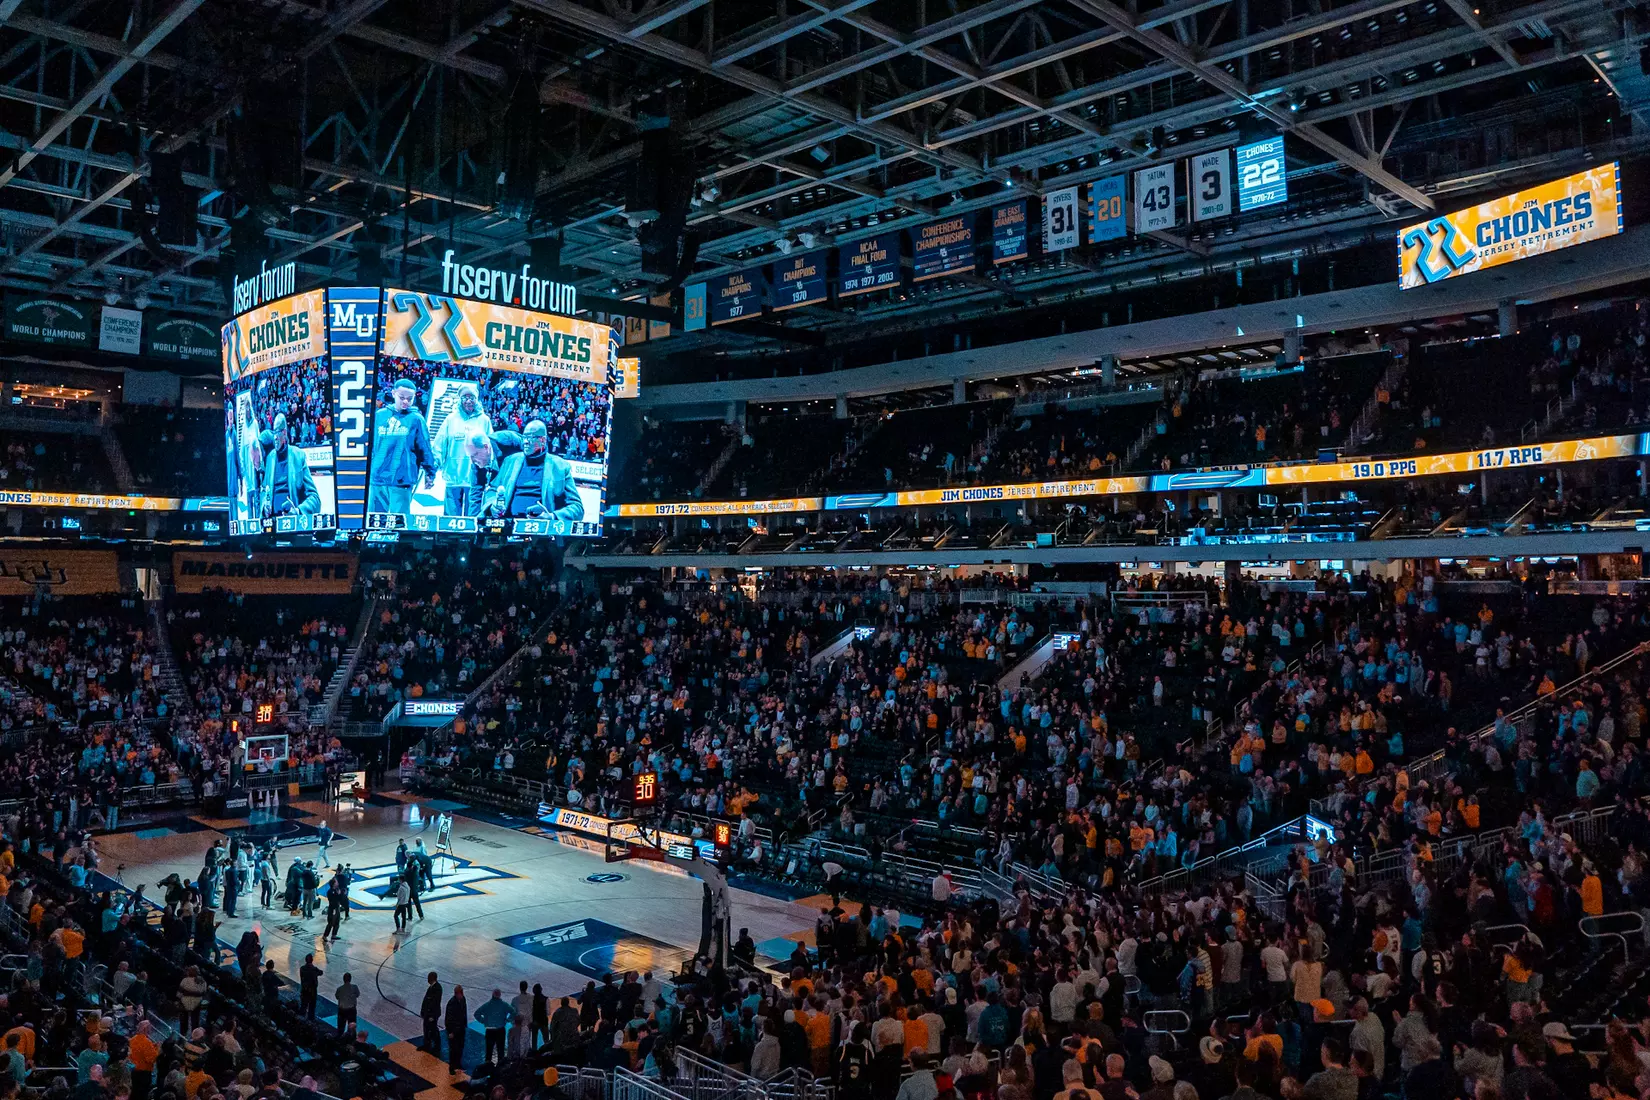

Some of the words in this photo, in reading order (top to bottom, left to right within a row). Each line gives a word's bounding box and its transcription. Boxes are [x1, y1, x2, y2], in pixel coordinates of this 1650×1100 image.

[1245, 144, 1273, 158] CHONES
[1202, 156, 1219, 168] WADE
[1148, 171, 1166, 181] TATUM
[1243, 158, 1280, 188] 22
[1202, 170, 1221, 200] 3
[1053, 193, 1072, 204] RIVERS
[1143, 185, 1170, 212] 43
[1523, 199, 1538, 209] JIM
[1098, 196, 1120, 221] 20
[1052, 204, 1074, 234] 31
[1476, 192, 1592, 248] CHONES
[922, 218, 964, 238] CONFERENCE
[916, 229, 971, 251] CHAMPIONSHIPS
[1478, 242, 1515, 258] JERSEY
[1521, 220, 1594, 246] RETIREMENT
[860, 240, 877, 253] NCAA
[1404, 216, 1476, 283] 22
[852, 253, 868, 266] FINAL
[870, 250, 886, 262] FOUR
[729, 275, 743, 286] NCAA
[784, 266, 816, 282] CHAMPIONS
[861, 276, 874, 286] 1977
[878, 272, 894, 283] 2003
[722, 283, 751, 297] CHAMPIONS
[793, 290, 807, 302] 1970
[688, 297, 703, 318] 31
[730, 306, 743, 316] 1977
[104, 316, 140, 327] CONFERENCE
[333, 304, 374, 337] MU
[394, 292, 483, 361] 22
[536, 321, 550, 329] JIM
[12, 324, 39, 336] WORLD
[42, 328, 86, 340] CHAMPIONS
[104, 325, 138, 335] CHAMPIONS
[249, 311, 310, 354] CHONES
[153, 342, 177, 352] WORLD
[180, 346, 217, 357] CHAMPIONS
[485, 322, 591, 363] CHONES
[251, 353, 268, 365] JERSEY
[271, 342, 311, 359] RETIREMENT
[485, 351, 524, 364] JERSEY
[529, 357, 592, 373] RETIREMENT
[339, 361, 365, 456] 22
[309, 451, 332, 462] SELECT
[1477, 451, 1504, 467] 11.7
[1509, 447, 1542, 464] RPG
[1353, 464, 1384, 478] 19.0
[1389, 460, 1416, 475] PPG
[941, 490, 959, 501] JIM
[963, 488, 1003, 499] CHONES
[1008, 486, 1036, 496] JERSEY
[1040, 484, 1095, 494] RETIREMENT
[37, 496, 70, 504] JERSEY
[75, 497, 131, 506] RETIREMENT
[655, 505, 689, 514] 1971-72
[282, 519, 291, 529] 23
[448, 519, 466, 530] 40
[486, 519, 505, 527] 9:35
[525, 522, 539, 532] 23
[180, 560, 349, 579] MARQUETTE
[414, 704, 456, 712] CHONES
[257, 712, 271, 722] 30
[640, 775, 654, 784] 9:35
[636, 784, 653, 800] 30
[562, 812, 590, 828] 1971-72
[1434, 961, 1441, 974] 3
[687, 1023, 694, 1034] 3
[711, 1021, 720, 1030] 23
[850, 1066, 860, 1078] 3
